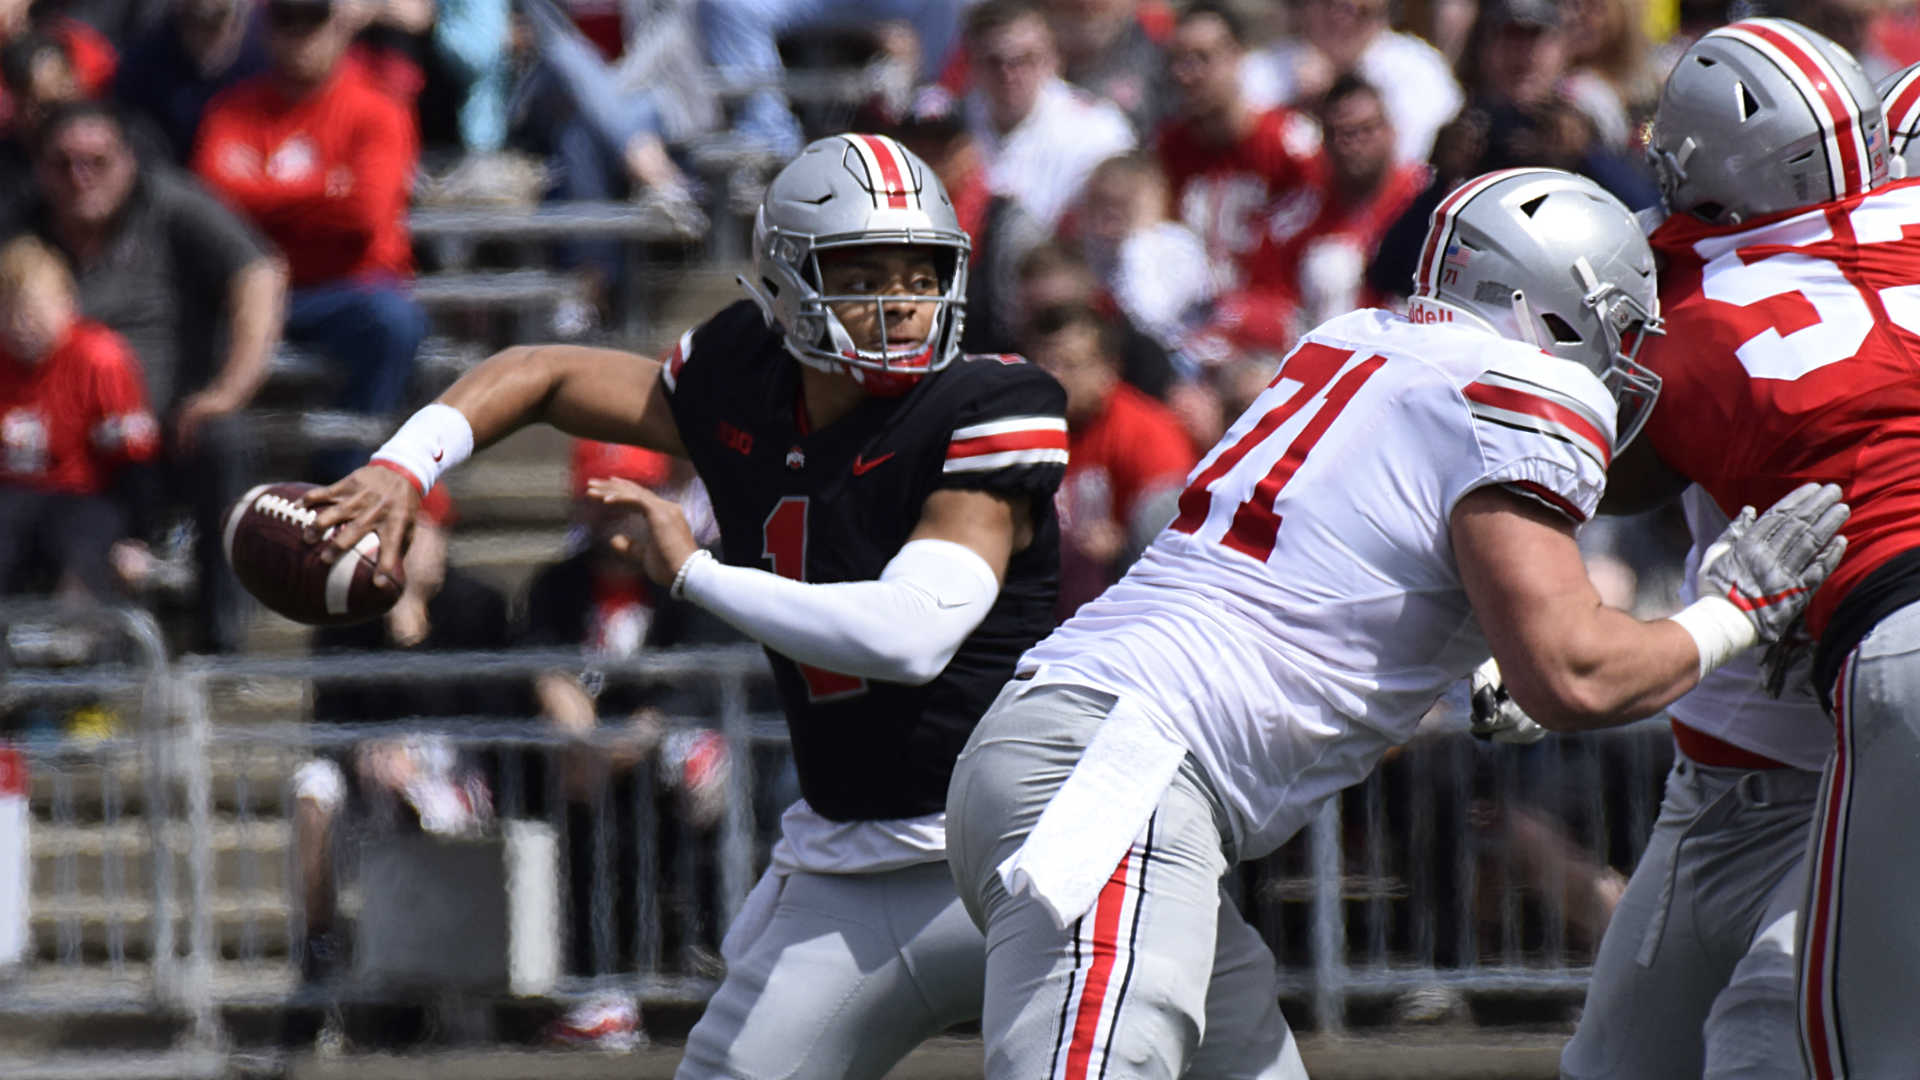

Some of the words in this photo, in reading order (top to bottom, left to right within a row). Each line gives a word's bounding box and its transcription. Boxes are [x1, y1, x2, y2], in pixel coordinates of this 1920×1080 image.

[1444, 268, 1459, 286] 71
[1168, 341, 1388, 563] 71
[762, 496, 868, 702] 1
